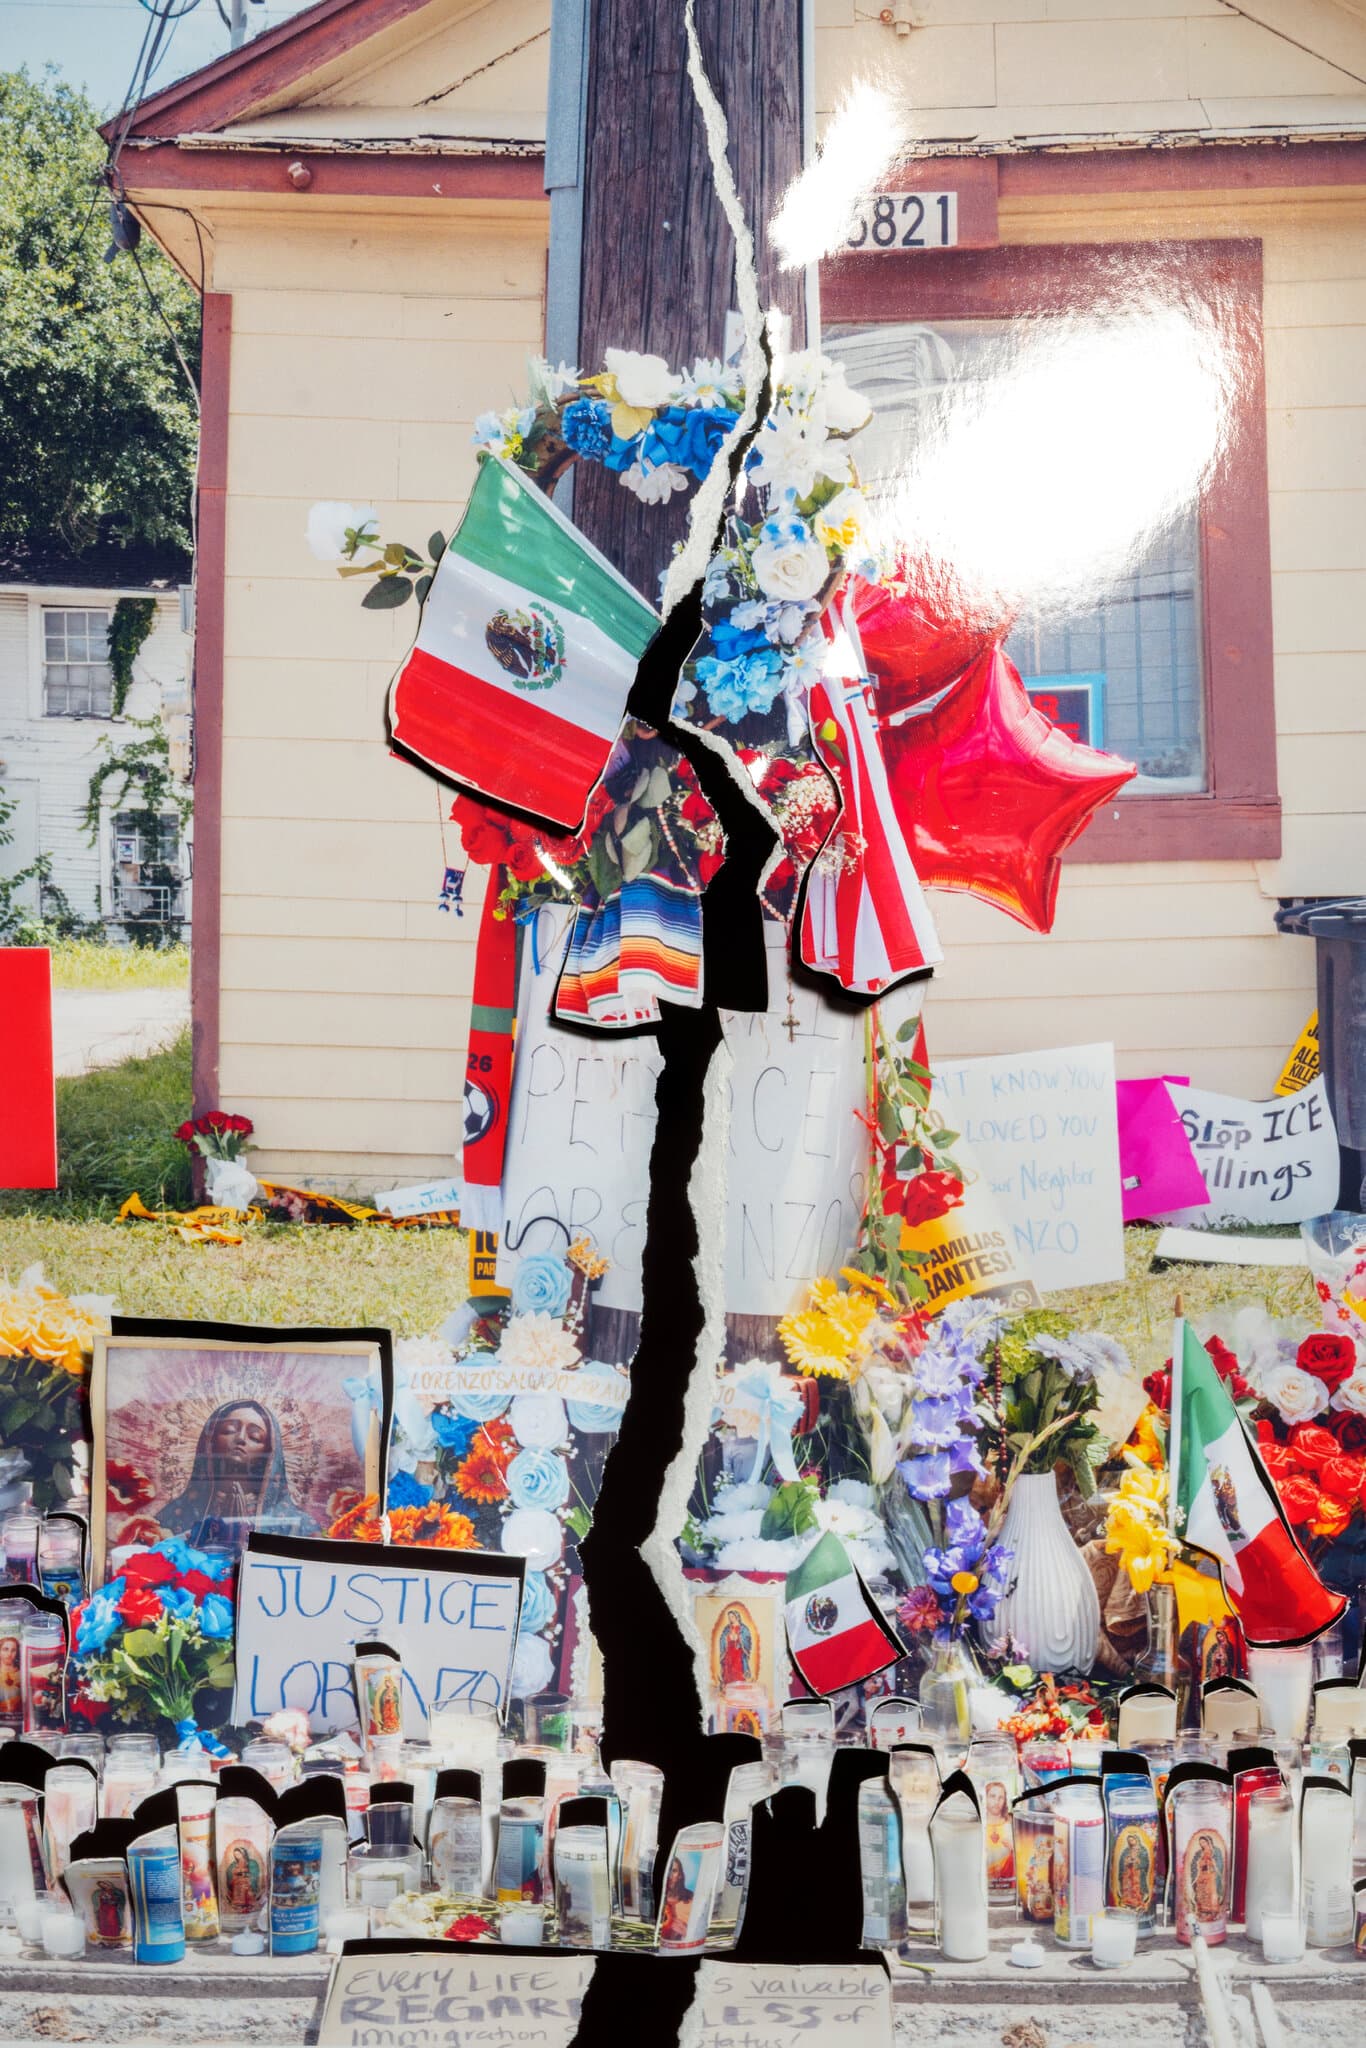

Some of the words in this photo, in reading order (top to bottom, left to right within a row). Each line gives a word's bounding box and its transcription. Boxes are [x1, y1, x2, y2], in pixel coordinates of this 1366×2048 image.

[991, 1068, 1058, 1098] KNOW
[1064, 1064, 1106, 1092] YOU
[966, 1113, 1047, 1143] LOVED
[1057, 1113, 1098, 1137] YOU
[1263, 1095, 1322, 1142] ICE
[1201, 1156, 1312, 1201] illings
[410, 1370, 491, 1392] LORENZO
[250, 1563, 513, 1631] JUSTICE
[250, 1654, 502, 1720] LORNZO
[469, 1969, 558, 1993] LIFE
[750, 1977, 885, 1997] valuable
